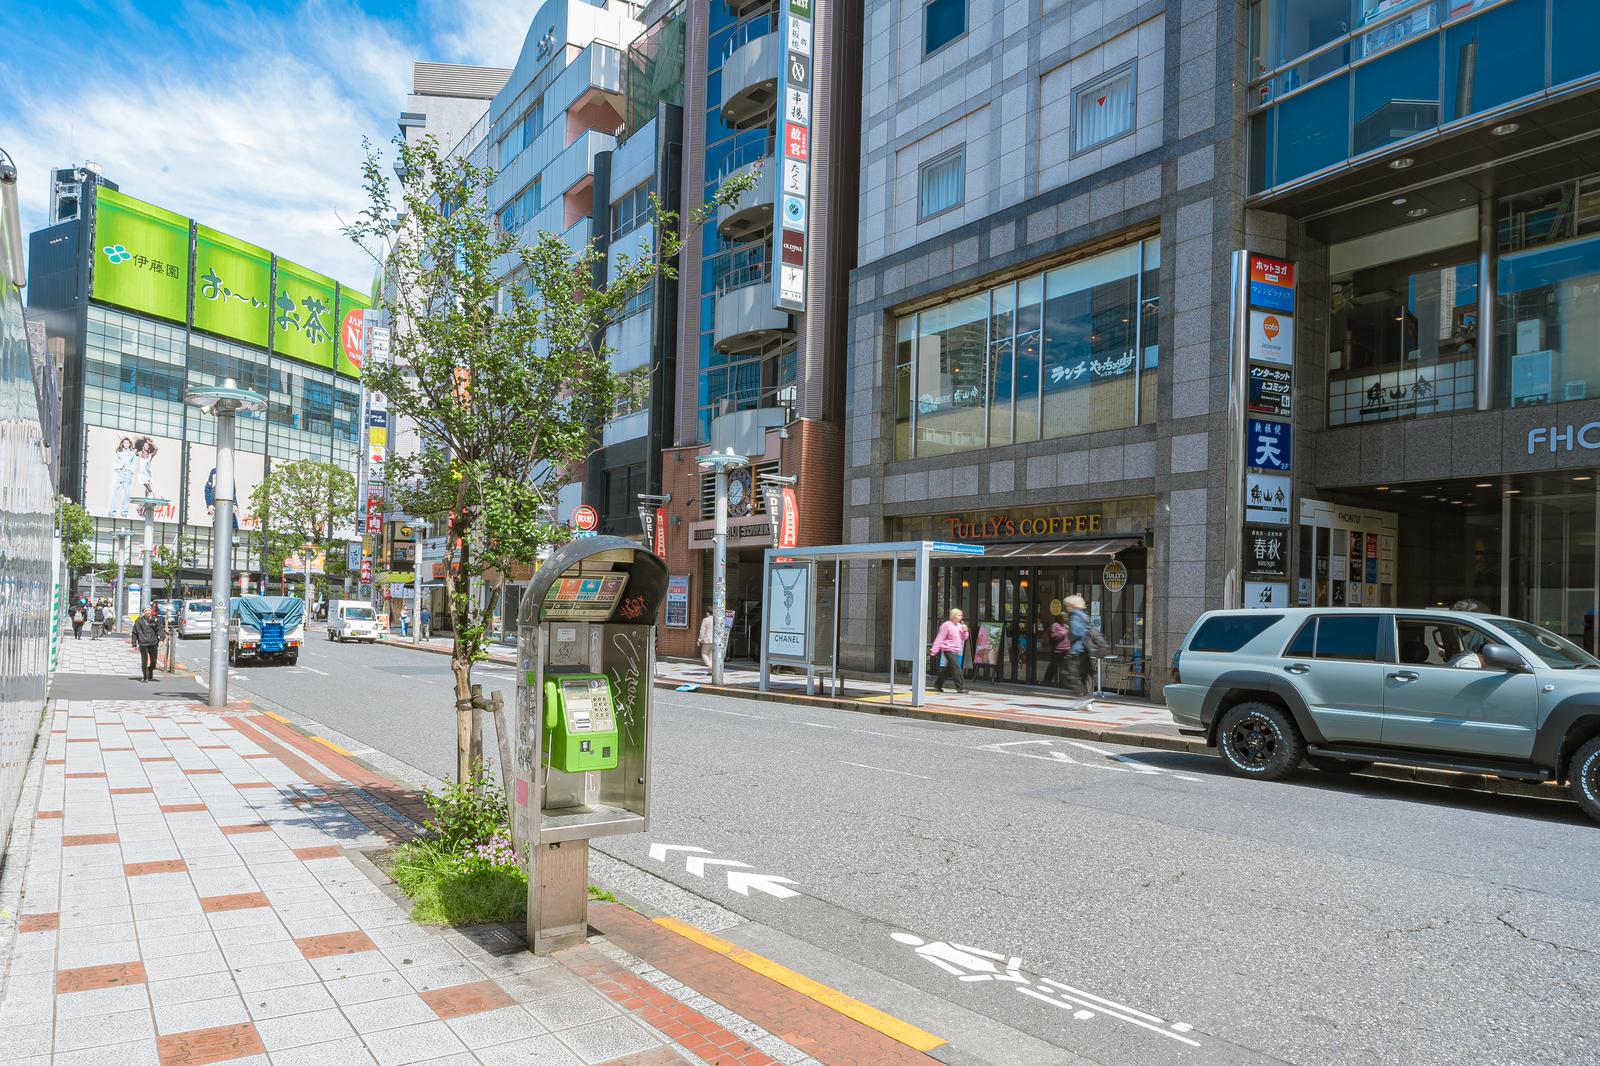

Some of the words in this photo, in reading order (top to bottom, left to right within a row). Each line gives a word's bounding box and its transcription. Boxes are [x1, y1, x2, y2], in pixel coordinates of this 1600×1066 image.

[790, 128, 801, 156] 故宮
[790, 163, 800, 190] たくみ
[132, 253, 179, 279] 伊藤園
[1256, 261, 1287, 275] ホットヨガ
[276, 290, 334, 344] お茶
[1264, 323, 1279, 331] coto
[1051, 361, 1087, 384] ランチ
[1251, 368, 1290, 381] インターネット
[1261, 381, 1290, 393] &コミック
[1255, 435, 1282, 467] 天
[770, 497, 779, 533] DELI
[1019, 514, 1102, 535] COFFEE
[1254, 538, 1280, 560] 春秋
[774, 634, 800, 643] CHANEL
[1250, 711, 1270, 721] TOYO
[1582, 750, 1600, 776] COUNT
[1582, 777, 1594, 800] OPEN
